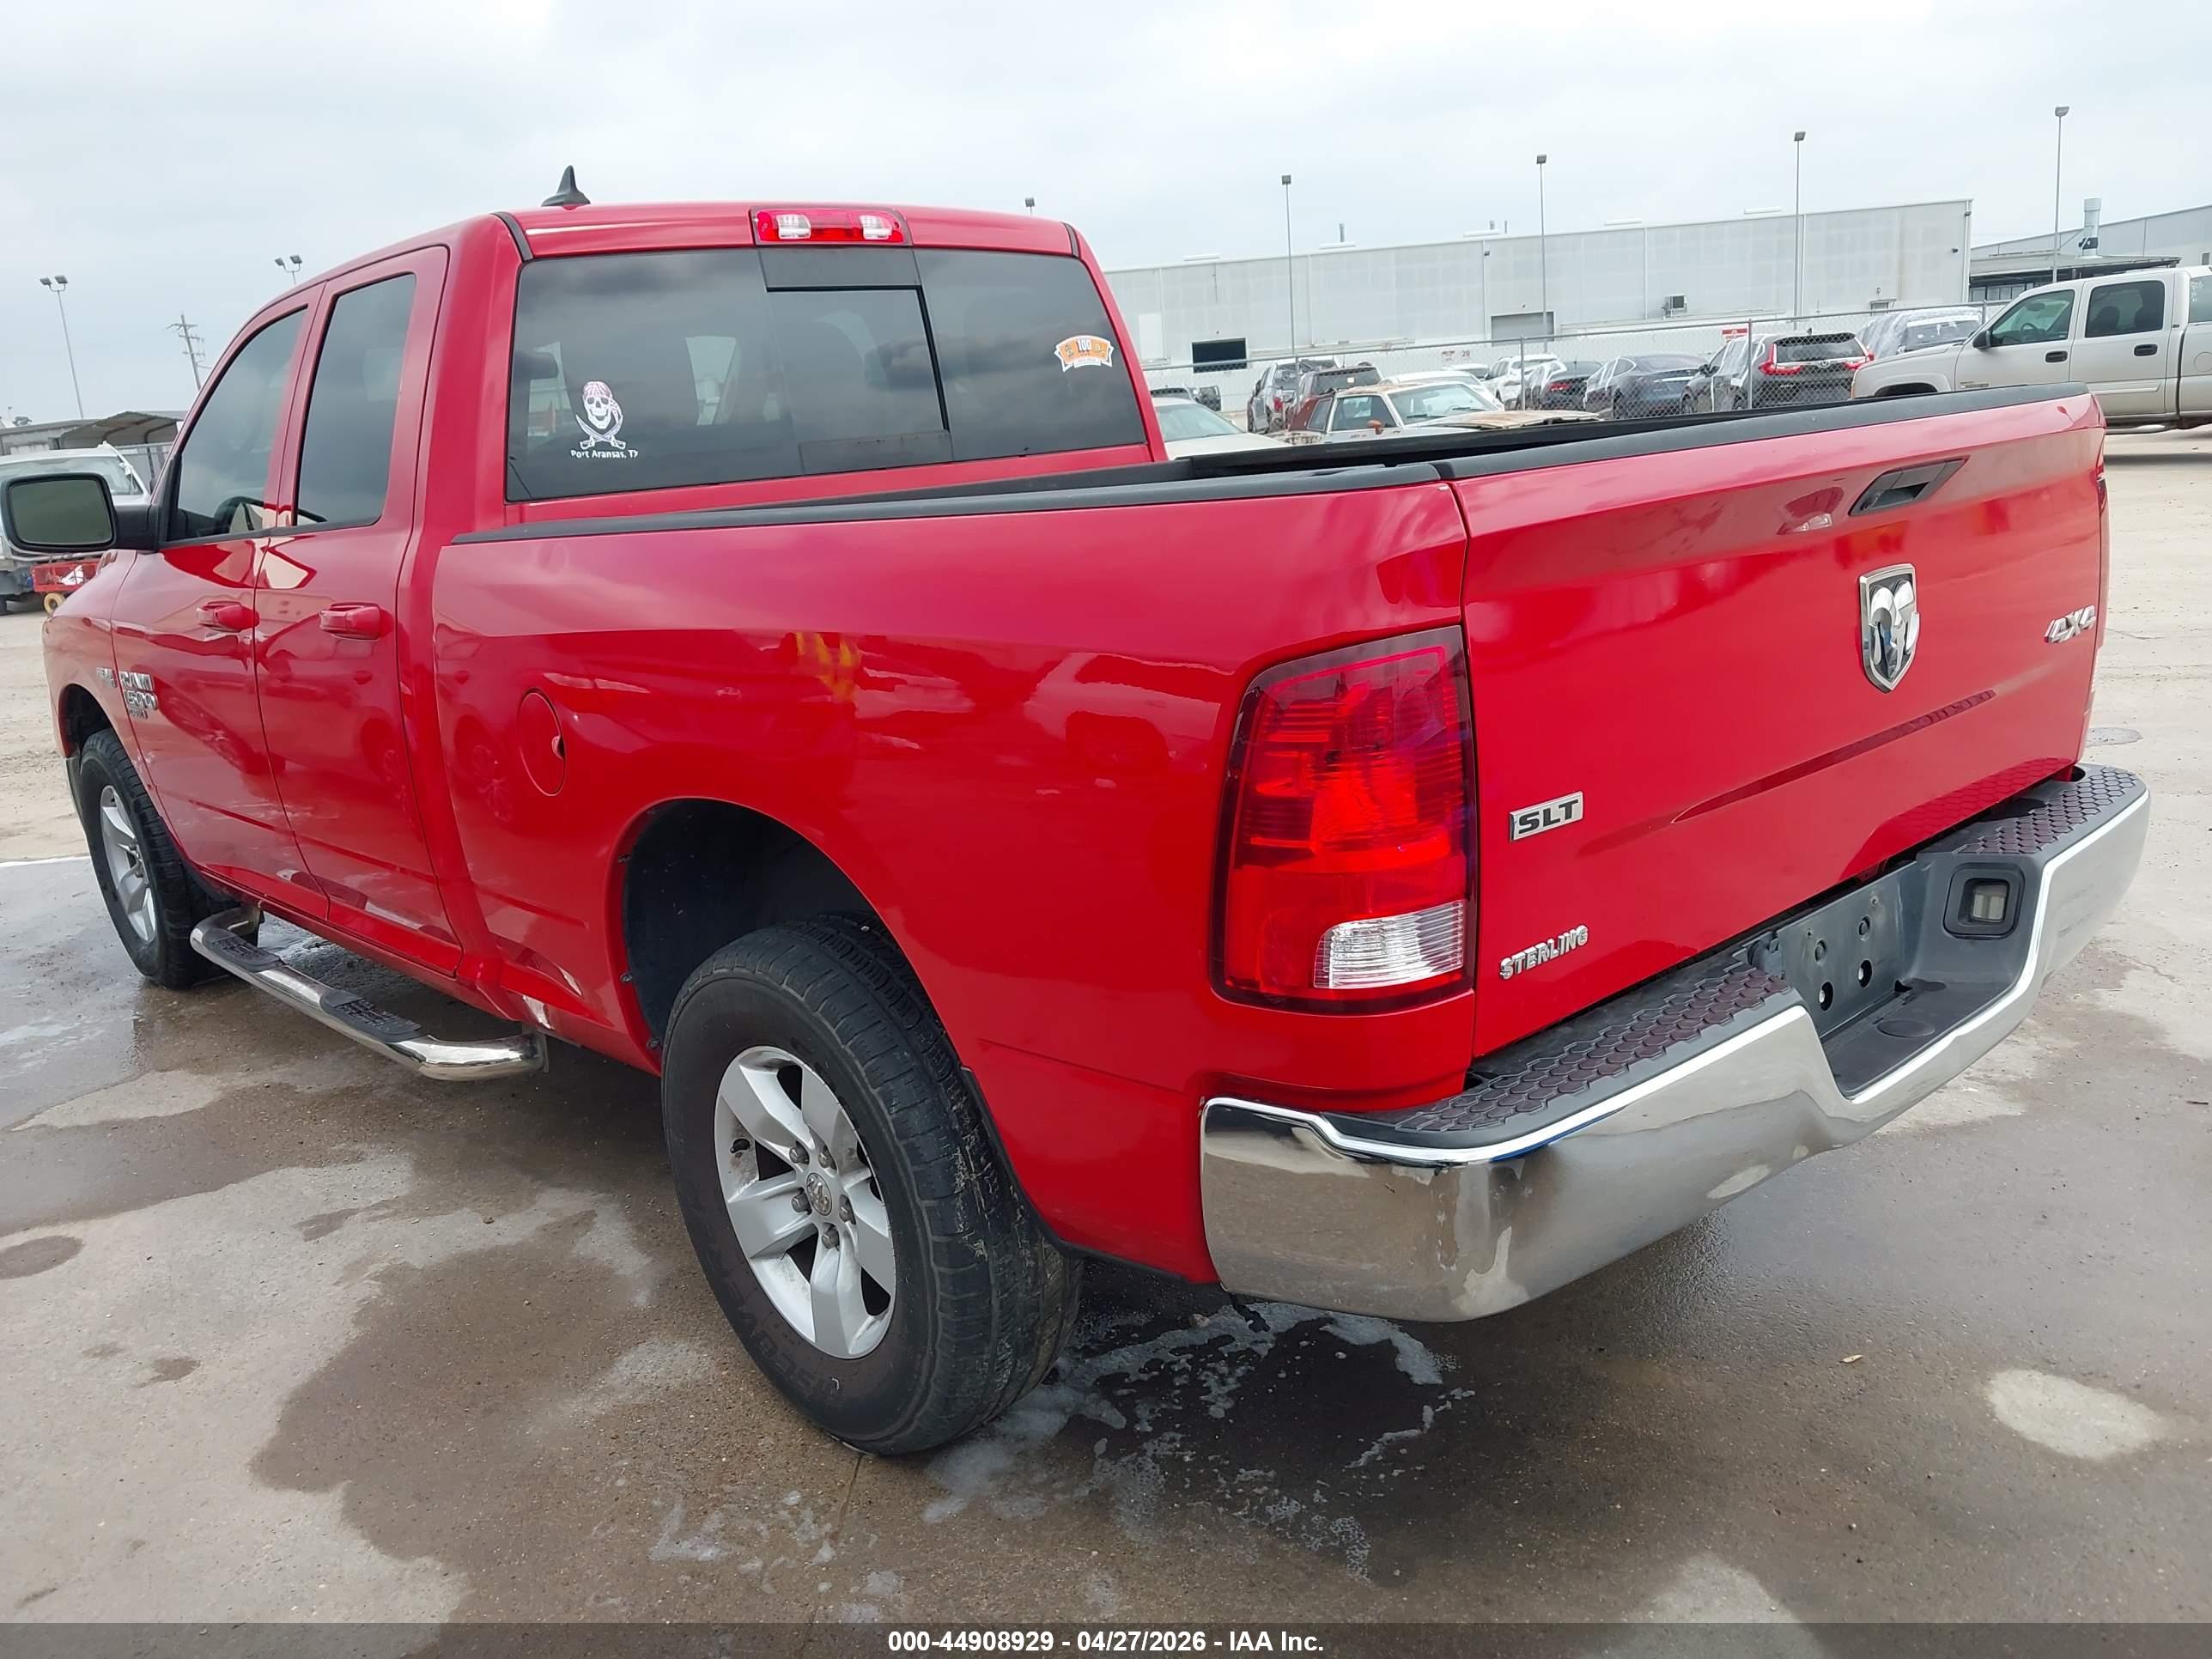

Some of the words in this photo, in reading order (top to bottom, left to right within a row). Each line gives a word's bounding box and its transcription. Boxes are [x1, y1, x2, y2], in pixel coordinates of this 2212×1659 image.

[570, 449, 590, 459] Port
[592, 449, 627, 459] Aransas,
[118, 671, 153, 692] RAM
[1517, 799, 1579, 835] SLT
[1499, 925, 1588, 980] STERLING
